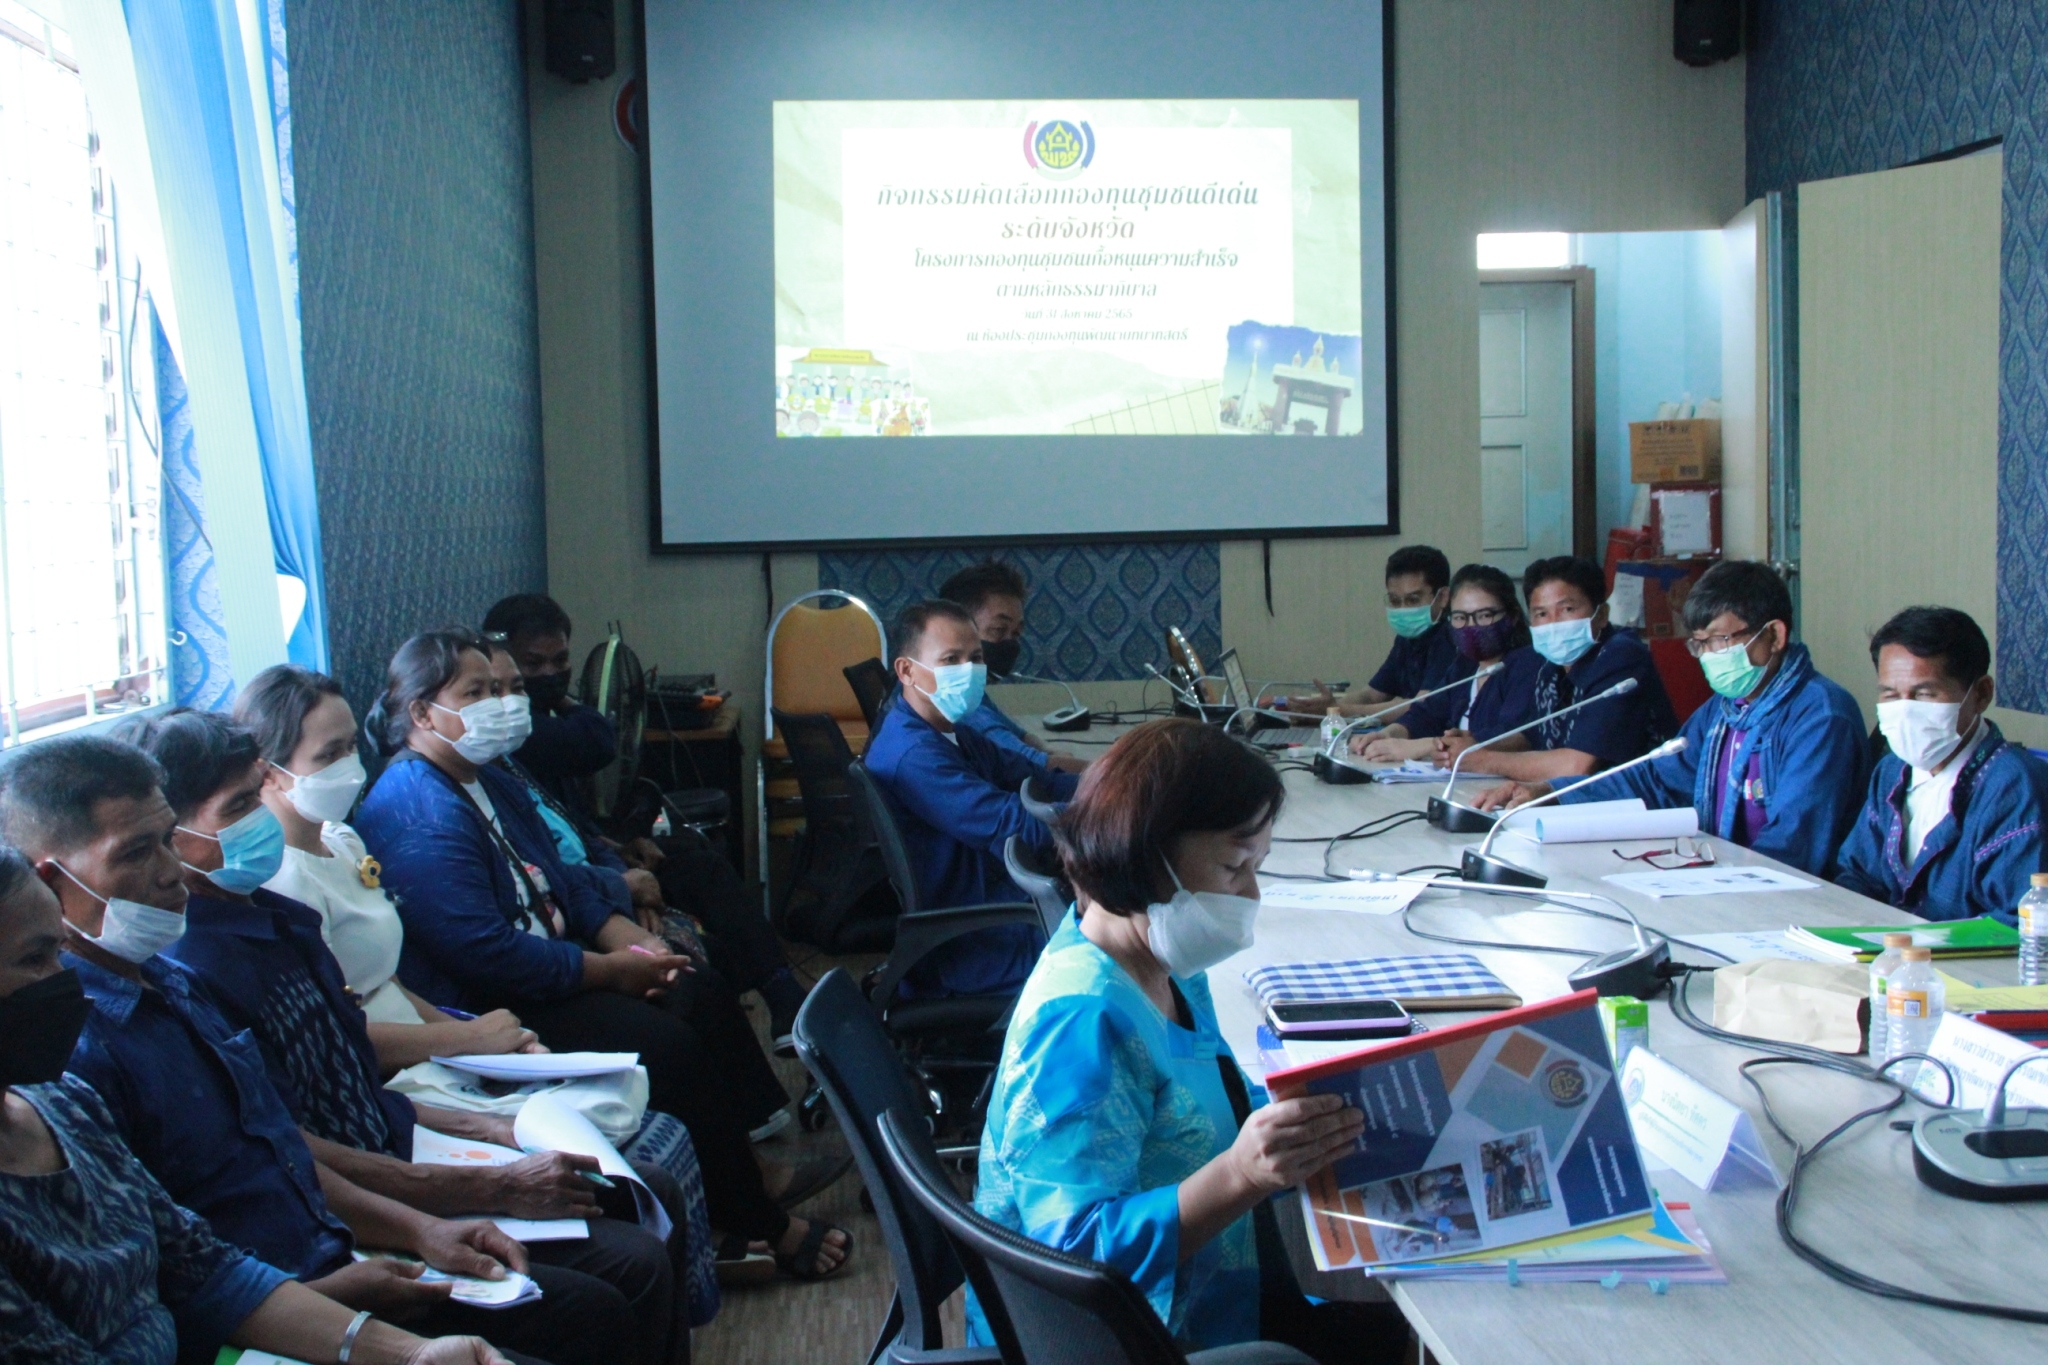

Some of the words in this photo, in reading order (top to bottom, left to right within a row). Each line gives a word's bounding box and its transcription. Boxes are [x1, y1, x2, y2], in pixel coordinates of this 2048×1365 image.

[877, 181, 1260, 211] กิจกรรมคัดเลือกกองทุนชุมชนดีเด่น
[1001, 216, 1136, 239] ระดับจังหวัด
[1105, 308, 1133, 319] 2565
